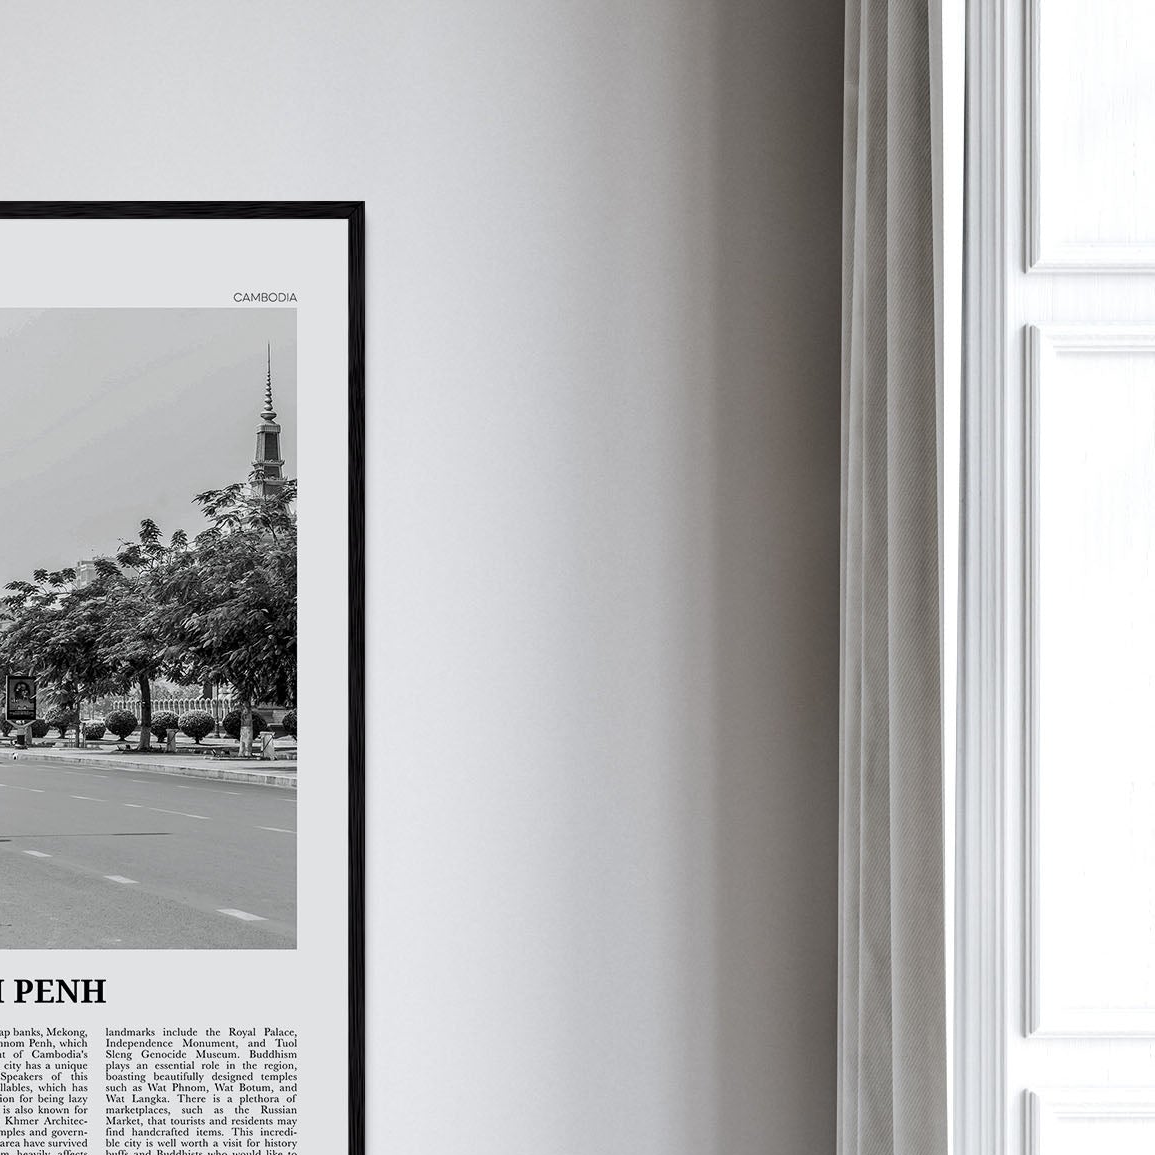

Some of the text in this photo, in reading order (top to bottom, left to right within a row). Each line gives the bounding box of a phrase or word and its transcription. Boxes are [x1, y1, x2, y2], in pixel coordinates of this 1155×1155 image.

[234, 293, 297, 302] CAMBODIA
[14, 979, 106, 1003] PENH
[13, 1028, 43, 1038] banks,
[46, 1028, 88, 1039] Mekong,
[106, 1028, 297, 1039] landmarks include the Royal Palace,
[29, 1039, 56, 1049] Penh,
[59, 1039, 88, 1048] which
[106, 1039, 297, 1050] Independence Monument, and Tuol
[13, 1050, 24, 1059] of
[31, 1050, 88, 1059] Cambodia's
[106, 1050, 297, 1061] Sleng Genocide Museum. Buddhism
[4, 1061, 22, 1072] city
[25, 1061, 42, 1070] has
[55, 1061, 88, 1072] unique
[0, 1072, 43, 1083] Speakers
[51, 1072, 62, 1081] of
[71, 1072, 88, 1081] this
[106, 1072, 297, 1083] boasting beautifully designed temples
[38, 1083, 66, 1092] which
[72, 1083, 88, 1092] has
[19, 1095, 33, 1103] for
[38, 1095, 64, 1106] being
[69, 1095, 88, 1106] lazy
[106, 1106, 171, 1117] marketplaces,
[181, 1106, 203, 1114] such
[234, 1106, 250, 1114] the
[261, 1106, 297, 1114] Russian
[5, 1117, 39, 1125] Khmer
[44, 1117, 88, 1125] Architec-
[106, 1117, 297, 1128] Market, that tourists and residents may
[106, 1128, 297, 1137] find handcrafted items. This incredi-
